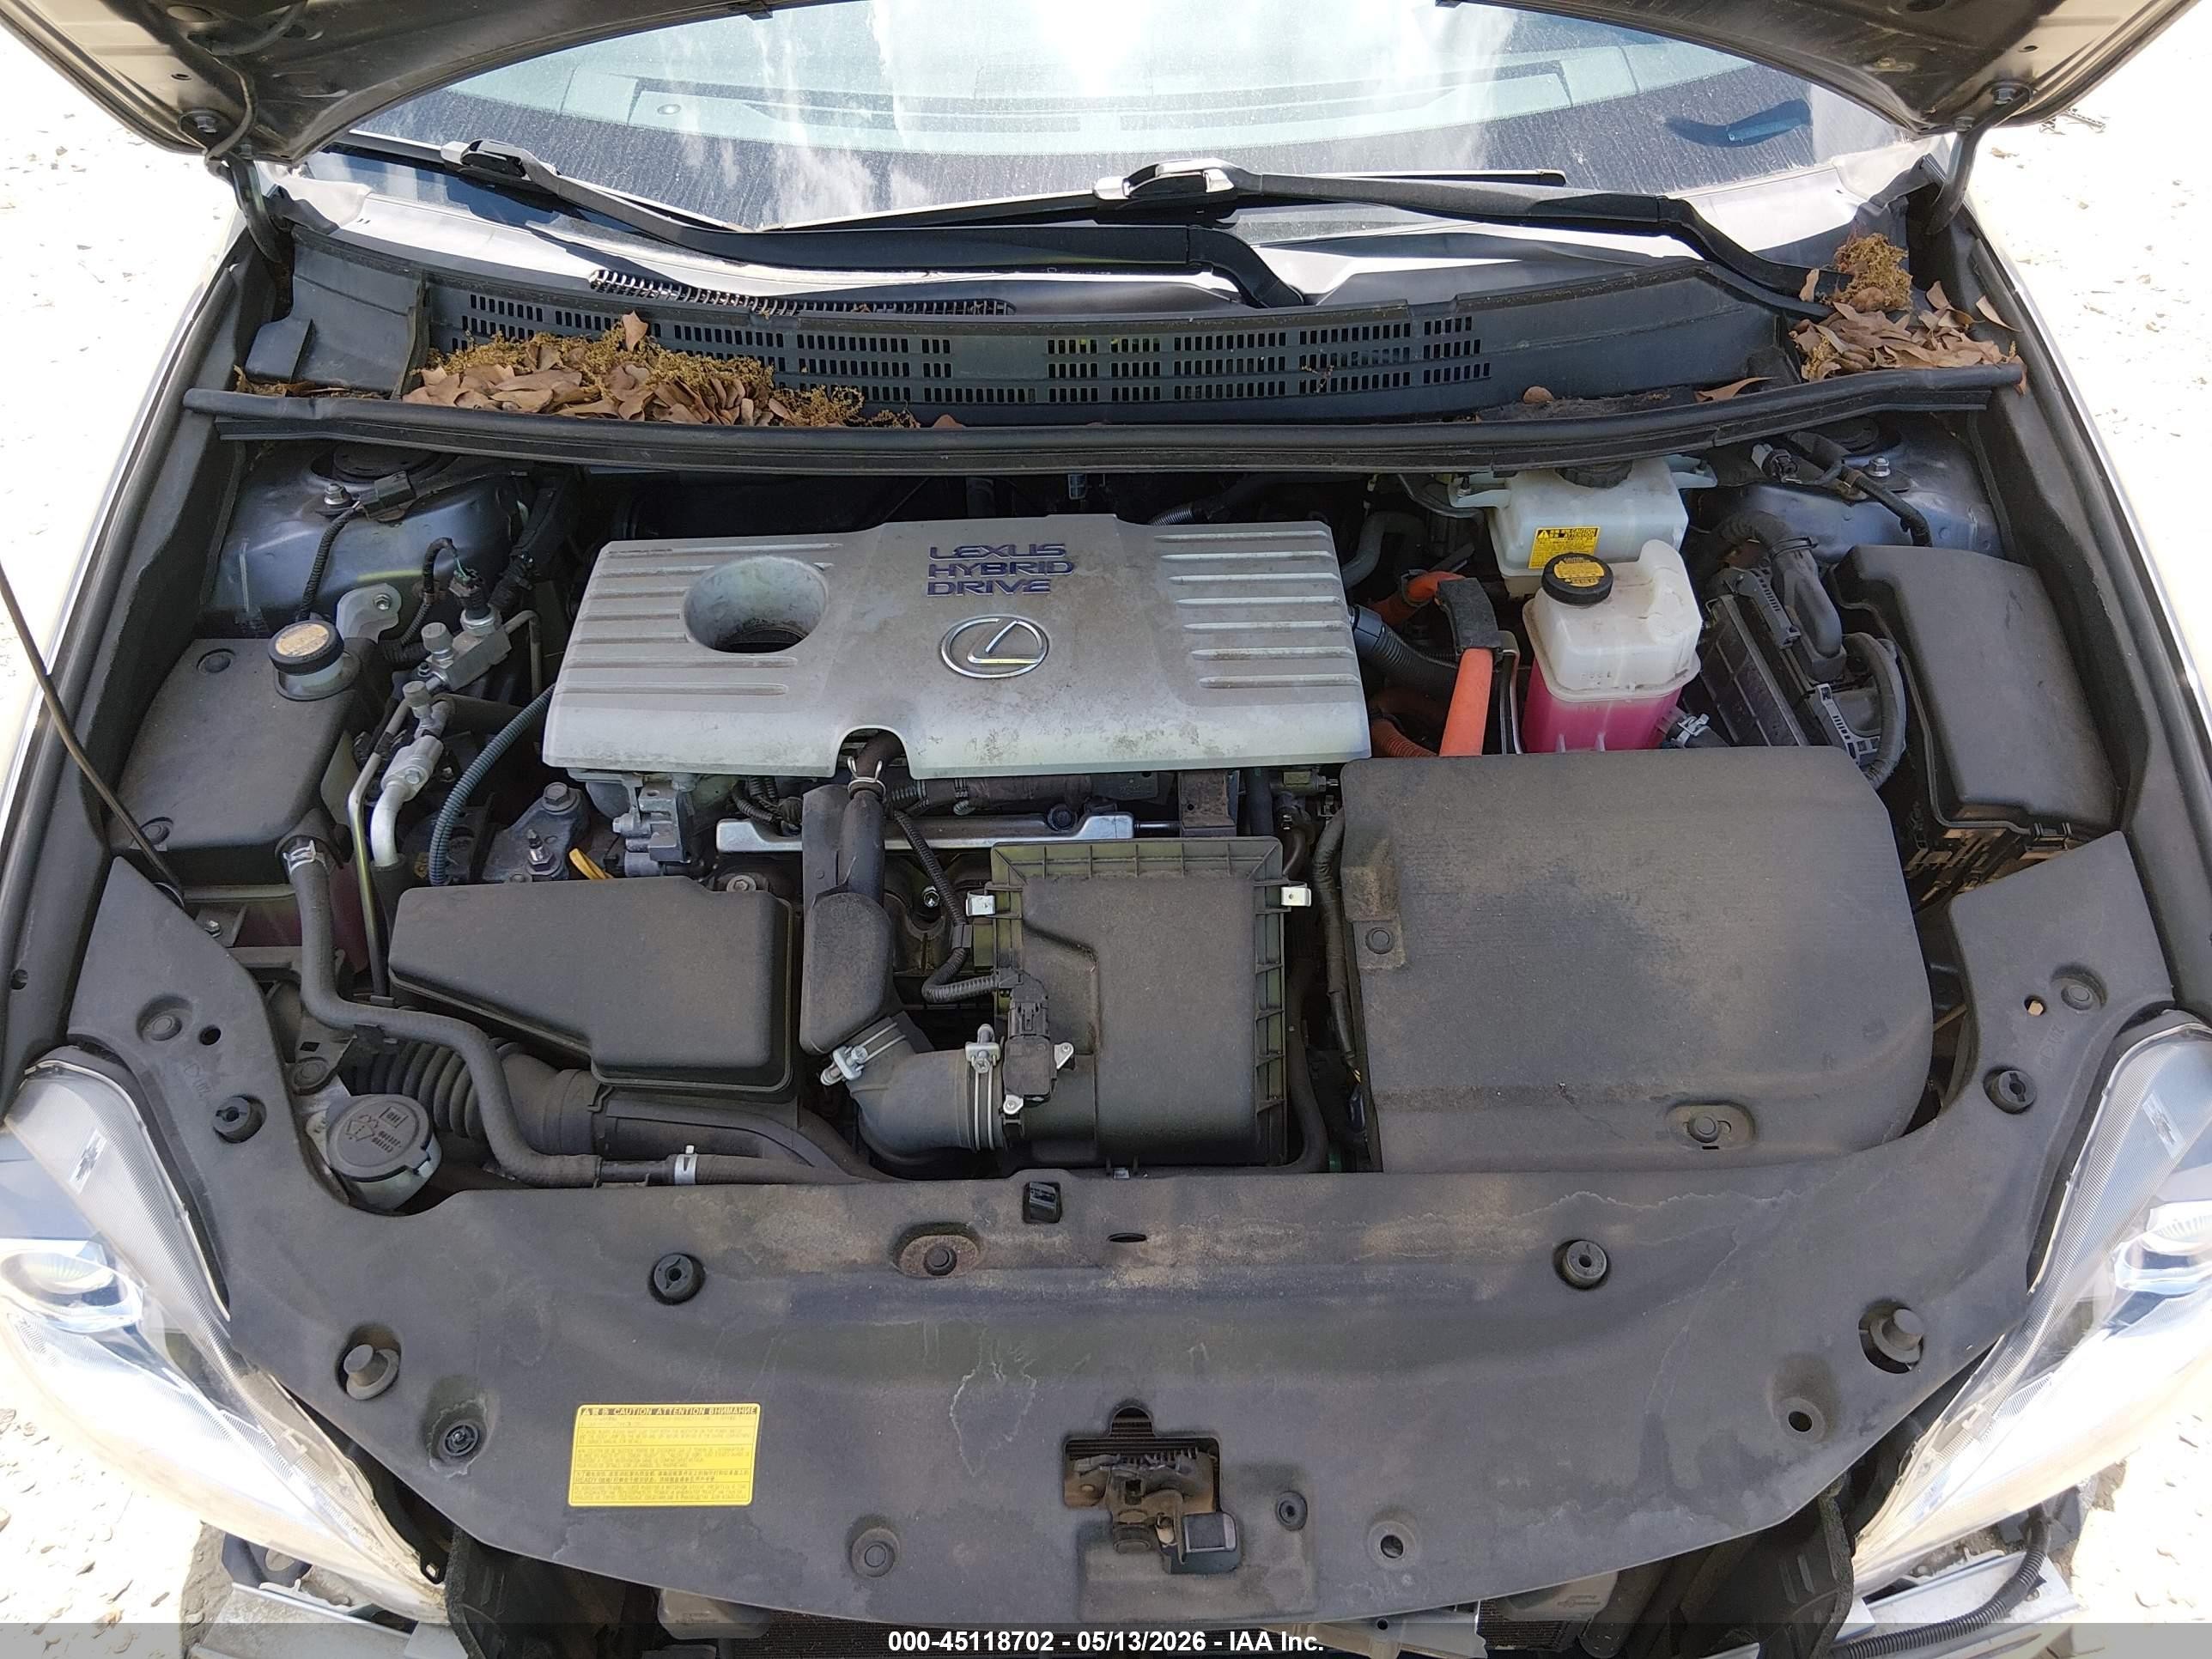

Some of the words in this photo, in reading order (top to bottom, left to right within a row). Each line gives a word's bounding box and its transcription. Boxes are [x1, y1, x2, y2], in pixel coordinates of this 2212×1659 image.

[930, 544, 1066, 560] LEXUS
[928, 561, 1075, 578] HYBRID
[927, 579, 1051, 597] DRIVE
